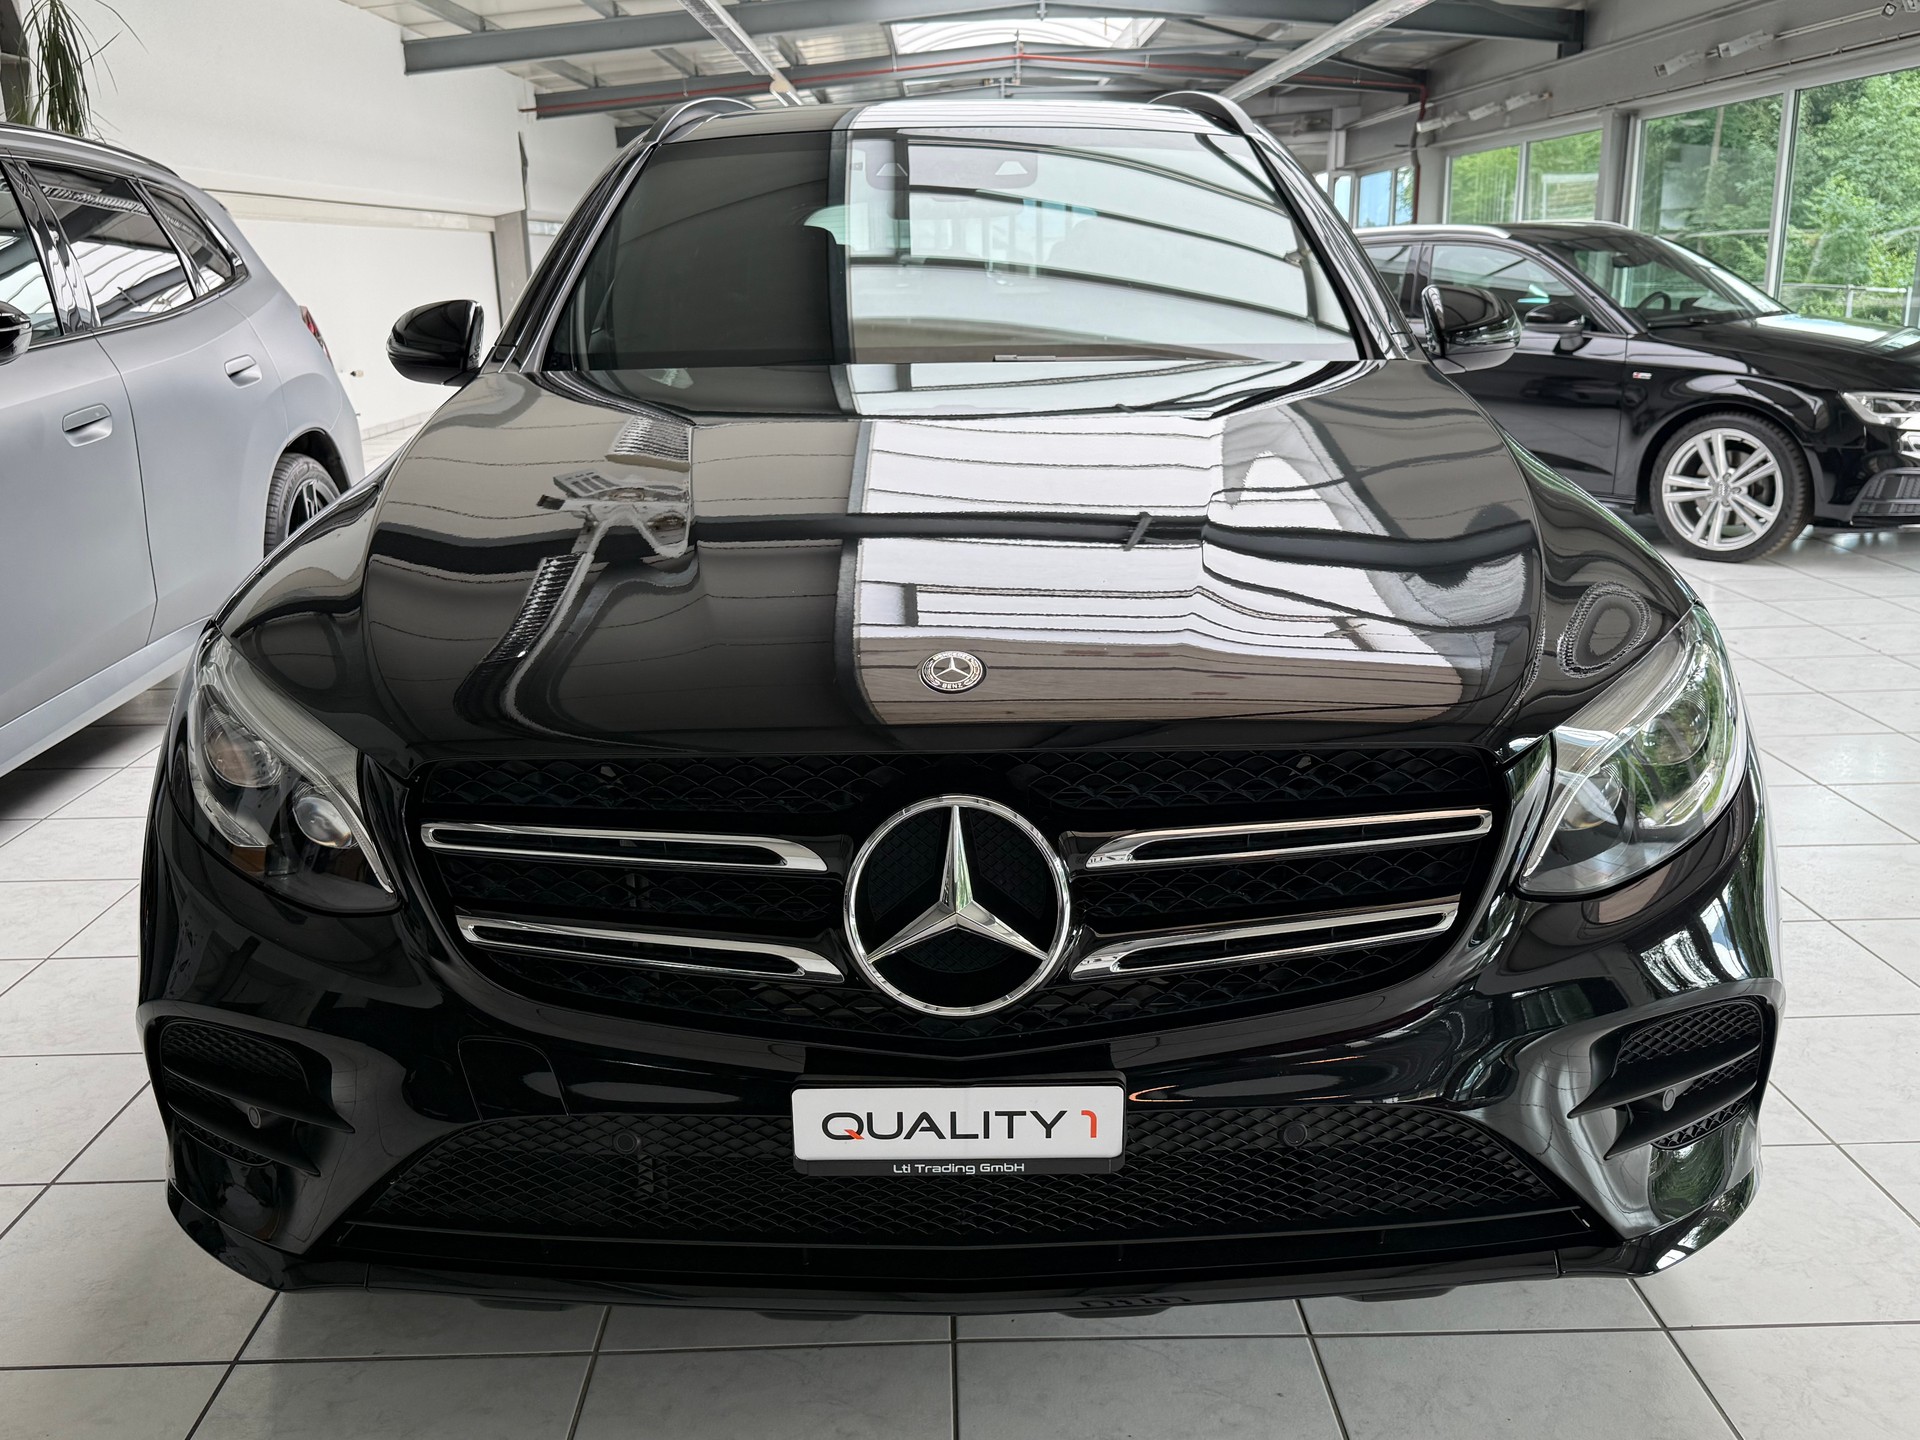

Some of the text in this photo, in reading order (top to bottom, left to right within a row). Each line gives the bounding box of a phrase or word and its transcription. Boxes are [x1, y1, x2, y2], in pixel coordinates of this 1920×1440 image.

[821, 1110, 1098, 1140] QUALITY 1
[893, 1162, 1025, 1175] Lti Trading GmbH
